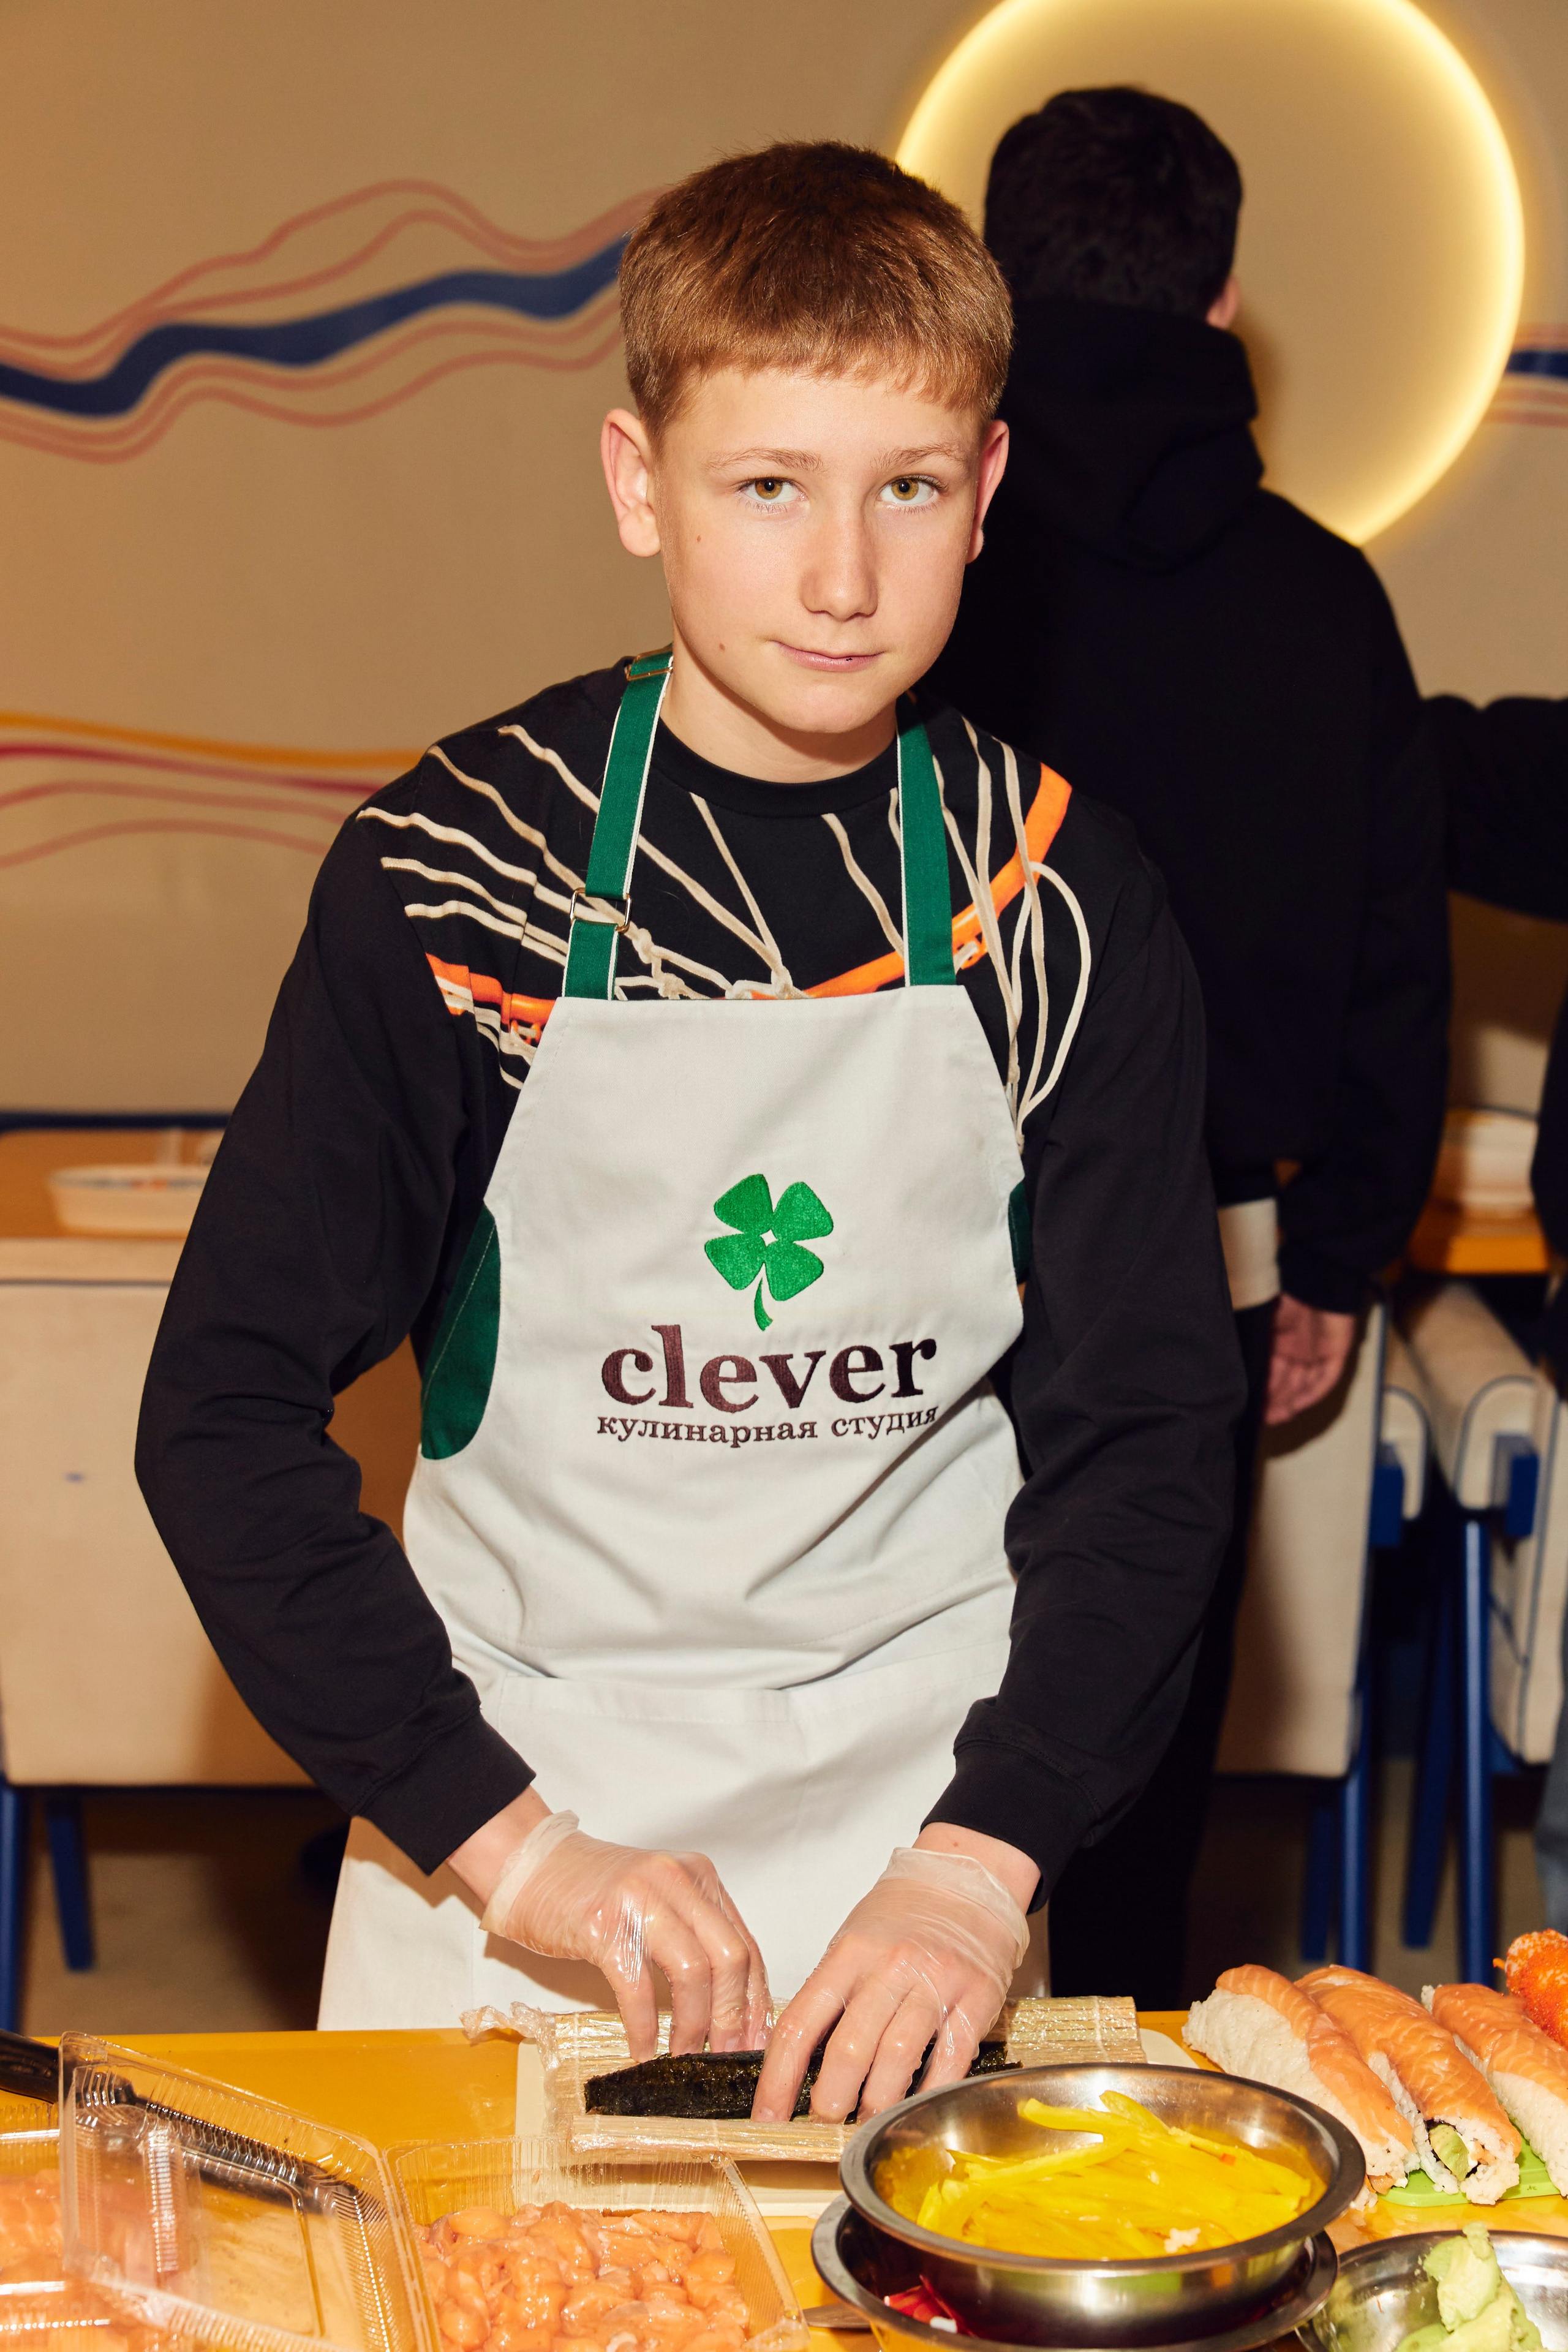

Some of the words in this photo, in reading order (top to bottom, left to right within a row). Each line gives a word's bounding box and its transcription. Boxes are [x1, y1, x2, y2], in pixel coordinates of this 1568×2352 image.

[601, 1324, 937, 1412] clever
[597, 1416, 818, 1448] кулинарная
[831, 1406, 938, 1439] студия
